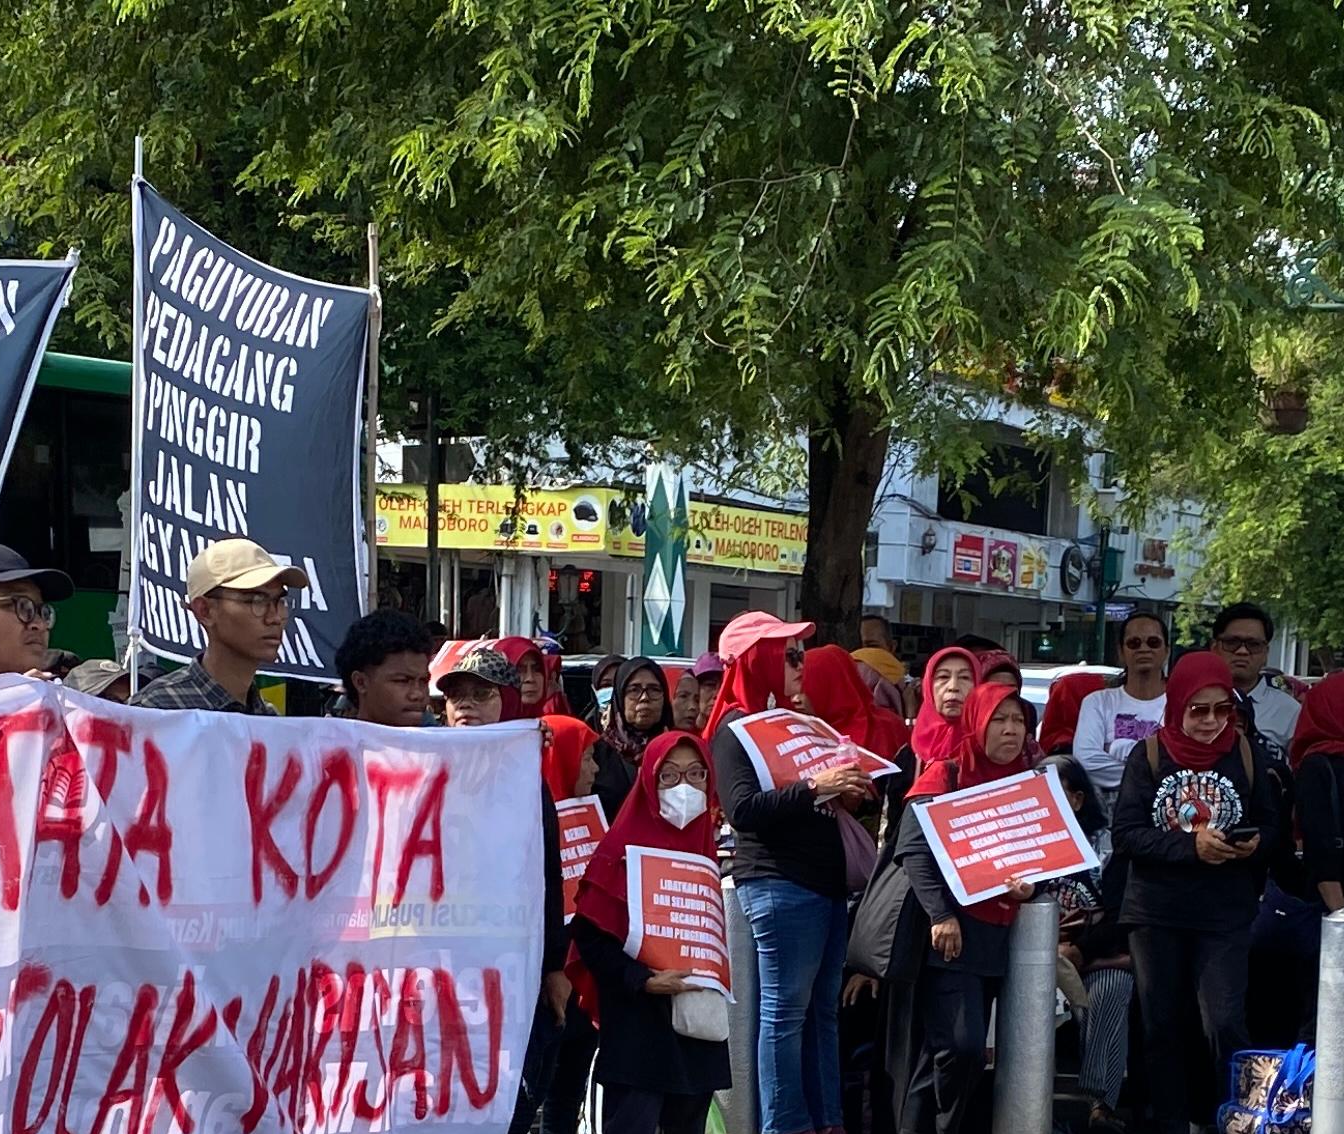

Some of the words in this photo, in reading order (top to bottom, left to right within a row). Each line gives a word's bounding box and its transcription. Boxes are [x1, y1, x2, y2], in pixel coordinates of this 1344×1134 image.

[149, 216, 335, 350] PAGUYUBAN
[143, 292, 299, 414] PEDAGANG
[147, 372, 263, 474] PINGGIR
[148, 450, 250, 538] JALAN
[399, 515, 488, 532] MALOBORO
[246, 740, 450, 908] KOTA
